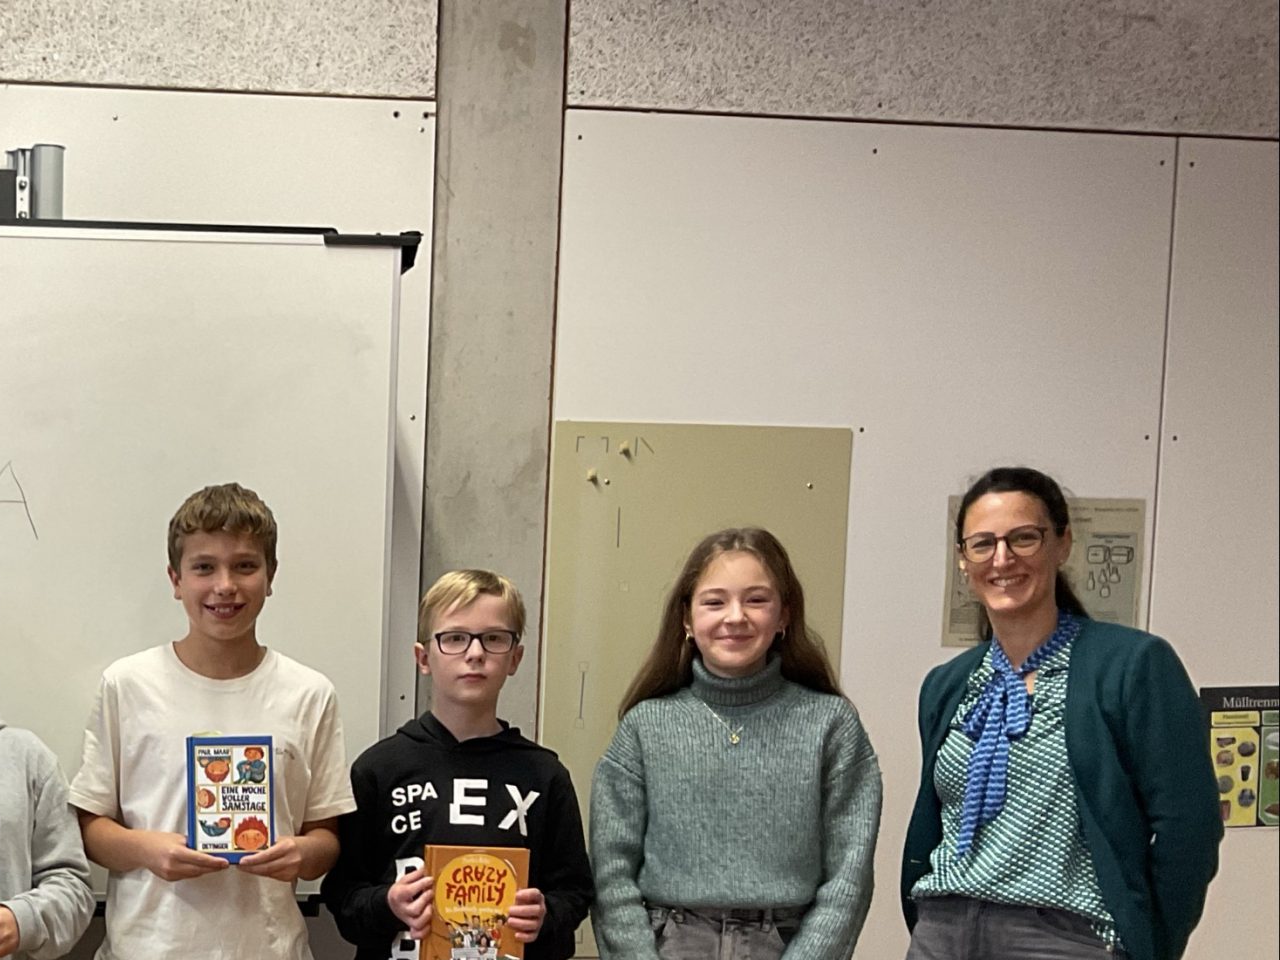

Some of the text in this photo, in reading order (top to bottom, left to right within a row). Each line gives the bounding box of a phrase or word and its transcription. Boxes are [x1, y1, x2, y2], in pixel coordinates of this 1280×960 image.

[1223, 696, 1279, 708] Mülltrenn
[221, 786, 266, 795] EINE WOCHE
[391, 781, 438, 806] SPA
[222, 794, 250, 802] VOLLER
[222, 802, 266, 811] SAMSTAGE
[391, 810, 422, 834] CE
[452, 865, 508, 884] CRAZY
